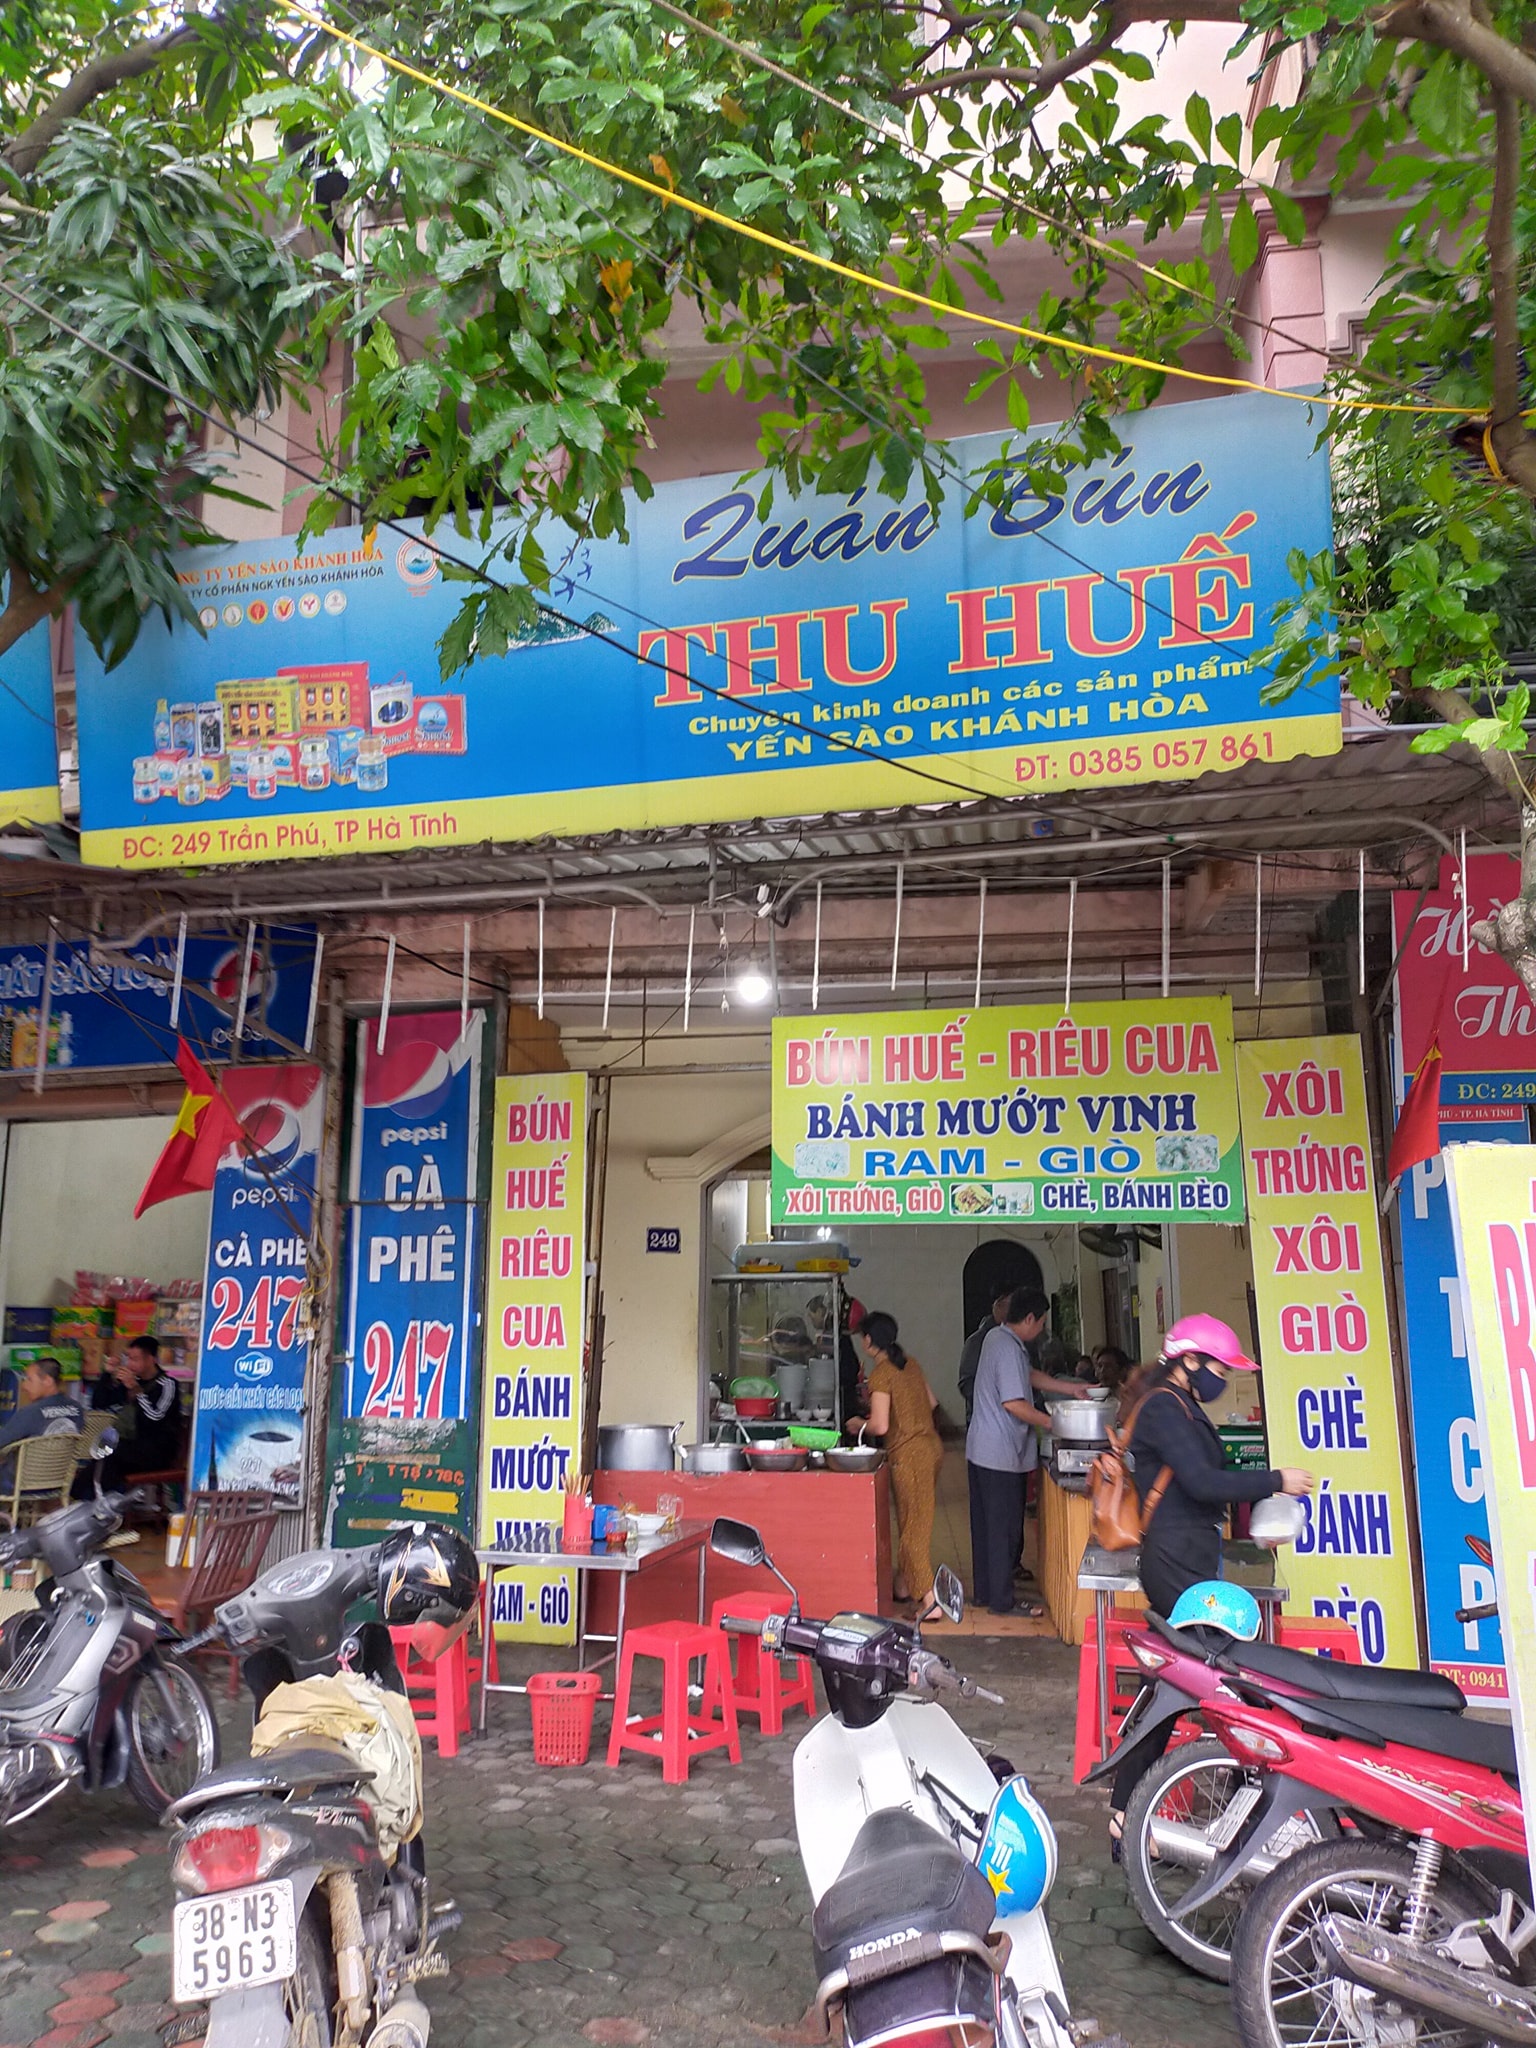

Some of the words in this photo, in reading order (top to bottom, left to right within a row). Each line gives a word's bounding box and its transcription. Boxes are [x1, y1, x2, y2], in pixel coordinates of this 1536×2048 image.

[673, 486, 938, 584] Quán
[204, 567, 224, 583] TY
[259, 558, 289, 575] SÀO
[293, 551, 347, 571] KHÁNH
[321, 568, 358, 583] KHÁNH
[638, 598, 908, 708] THU
[947, 511, 1258, 675] HUẾ
[689, 709, 799, 738] Chuyên
[811, 698, 881, 726] kinh
[893, 686, 989, 716] doanh
[1003, 677, 1063, 702] các
[1076, 668, 1143, 695] sản
[1153, 655, 1252, 690] phẩm
[726, 728, 812, 763] YẾN
[826, 719, 913, 752] SÀO
[930, 703, 1088, 743] KHÁNH
[1109, 690, 1210, 723] HÒA
[1015, 753, 1060, 783] ĐT:
[1068, 745, 1142, 779] 0385
[1152, 738, 1208, 770] 057
[1219, 731, 1274, 764] 861
[123, 836, 164, 859] ĐC:
[171, 831, 211, 856] 249
[218, 823, 268, 852] Trần
[276, 821, 327, 849] Phú,
[335, 820, 360, 843] TP
[368, 815, 401, 841] Hà
[409, 812, 457, 838] Tĩnh
[785, 1028, 870, 1088] BÚN
[883, 1015, 968, 1083] HUẾ
[1009, 1018, 1111, 1080] RIÊU
[1124, 1023, 1221, 1076] CUA
[807, 1092, 924, 1141] BÁNH
[937, 1089, 1065, 1138] MƯỚT
[1078, 1092, 1198, 1134] VINH
[1262, 1062, 1345, 1118] XÔI
[1458, 1083, 1496, 1099] ĐC:
[1502, 1083, 1536, 1099] 249
[381, 1121, 448, 1147] pepsi
[507, 1093, 572, 1143] BÚN
[384, 1155, 446, 1212] CÀ
[506, 1153, 570, 1210] HUẾ
[865, 1146, 986, 1178] RAM
[1039, 1138, 1141, 1174] GIÒ
[1251, 1135, 1368, 1196] TRỨNG
[232, 1182, 296, 1209] pepsi
[785, 1186, 823, 1216] XÔI
[826, 1179, 902, 1216] TRỨNG,
[907, 1179, 944, 1214] GIÒ
[1043, 1181, 1098, 1213] CHÈ,
[1104, 1177, 1172, 1211] BÁNH
[1179, 1179, 1229, 1209] BÈO
[214, 1231, 252, 1268] CÀ
[368, 1225, 456, 1282] PHÊ
[501, 1228, 573, 1278] RIÊU
[650, 1231, 677, 1248] 249
[1274, 1216, 1362, 1275] XÔI
[207, 1275, 306, 1350] 247
[503, 1305, 566, 1349] CUA
[1281, 1290, 1369, 1355] GIÒ
[361, 1320, 453, 1418] 247
[493, 1367, 572, 1418] BÁNH
[1297, 1376, 1369, 1452] CHÈ
[490, 1435, 571, 1492] MƯỚT
[1295, 1478, 1393, 1557] BÁNH
[540, 1577, 570, 1626] GIÒ
[1469, 1670, 1504, 1688] 0941
[194, 1892, 277, 1944] 38-N3
[849, 1927, 922, 1960] HONDA
[193, 1936, 277, 1989] 5963
